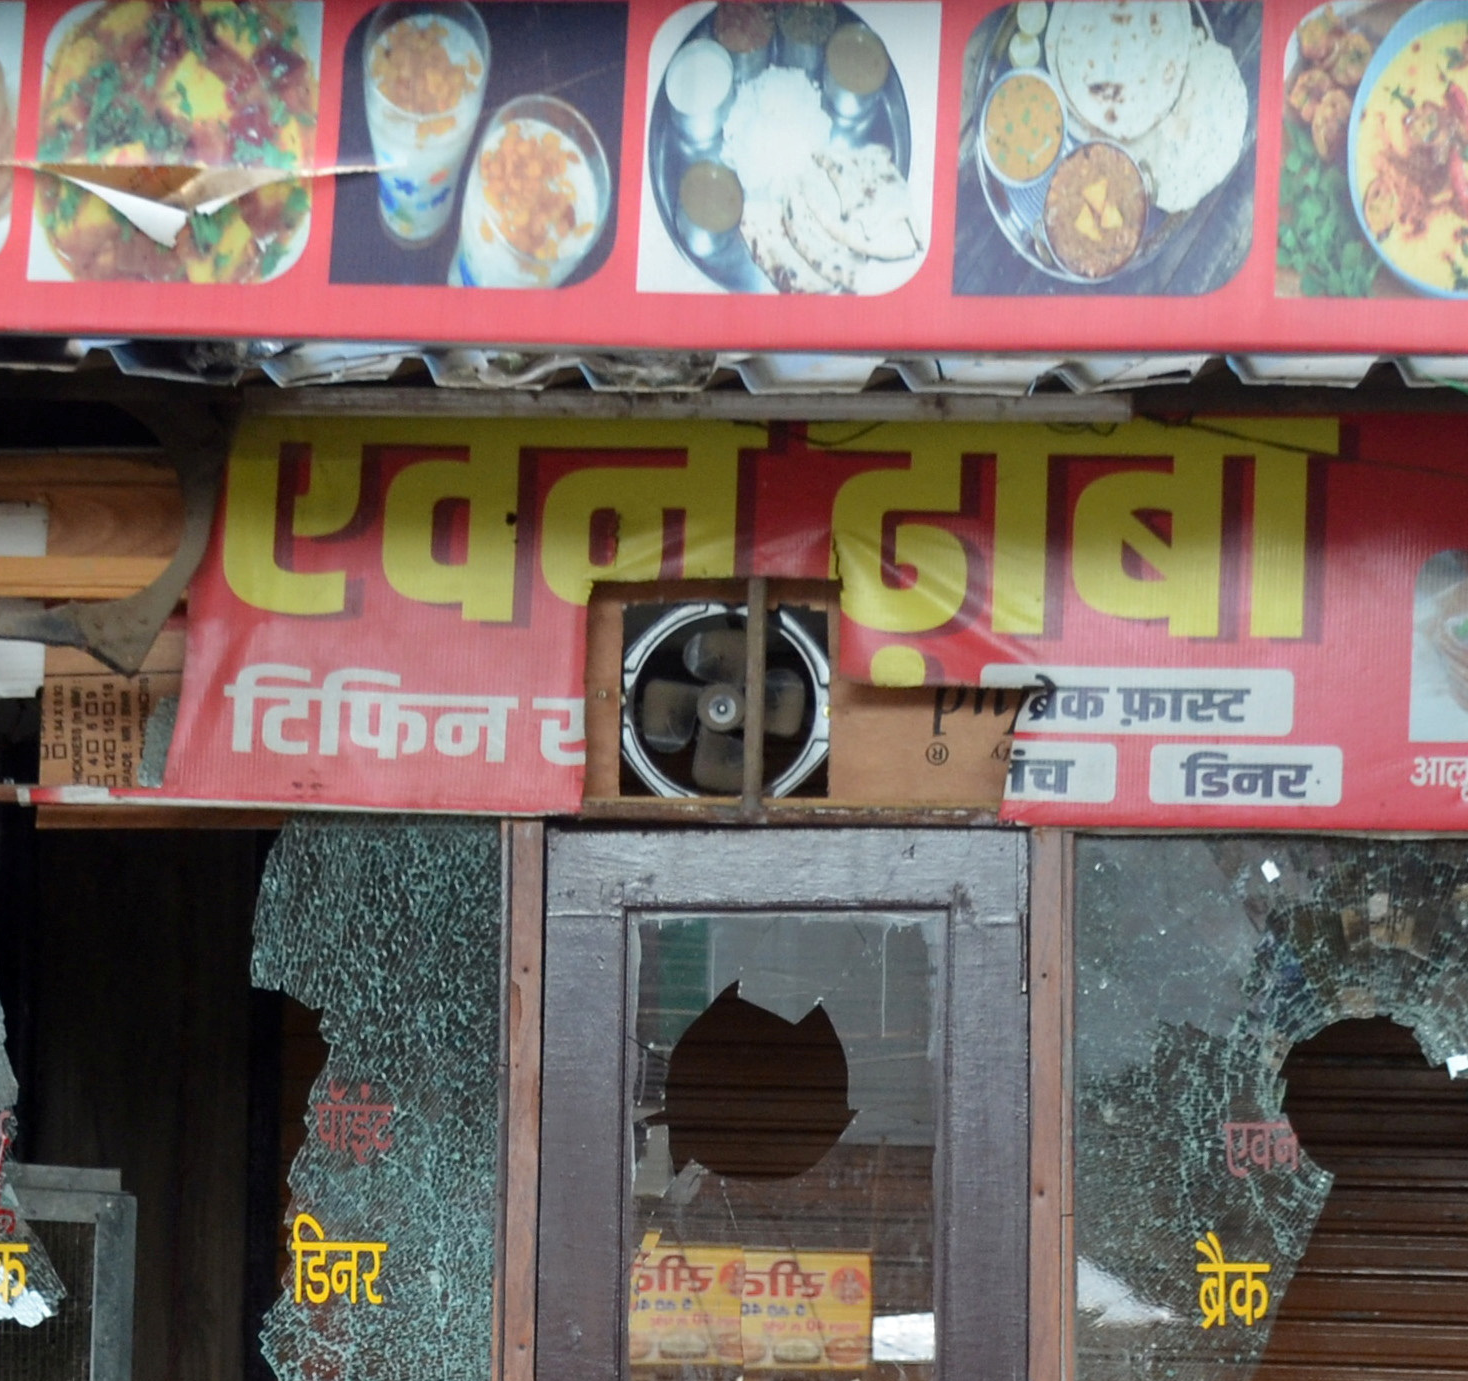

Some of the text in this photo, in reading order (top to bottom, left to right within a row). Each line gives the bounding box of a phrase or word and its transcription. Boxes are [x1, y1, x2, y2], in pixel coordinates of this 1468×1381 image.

[223, 663, 519, 764] टिफिन
[1179, 752, 1313, 798] डिनर
[290, 1212, 390, 1306] डिनर
